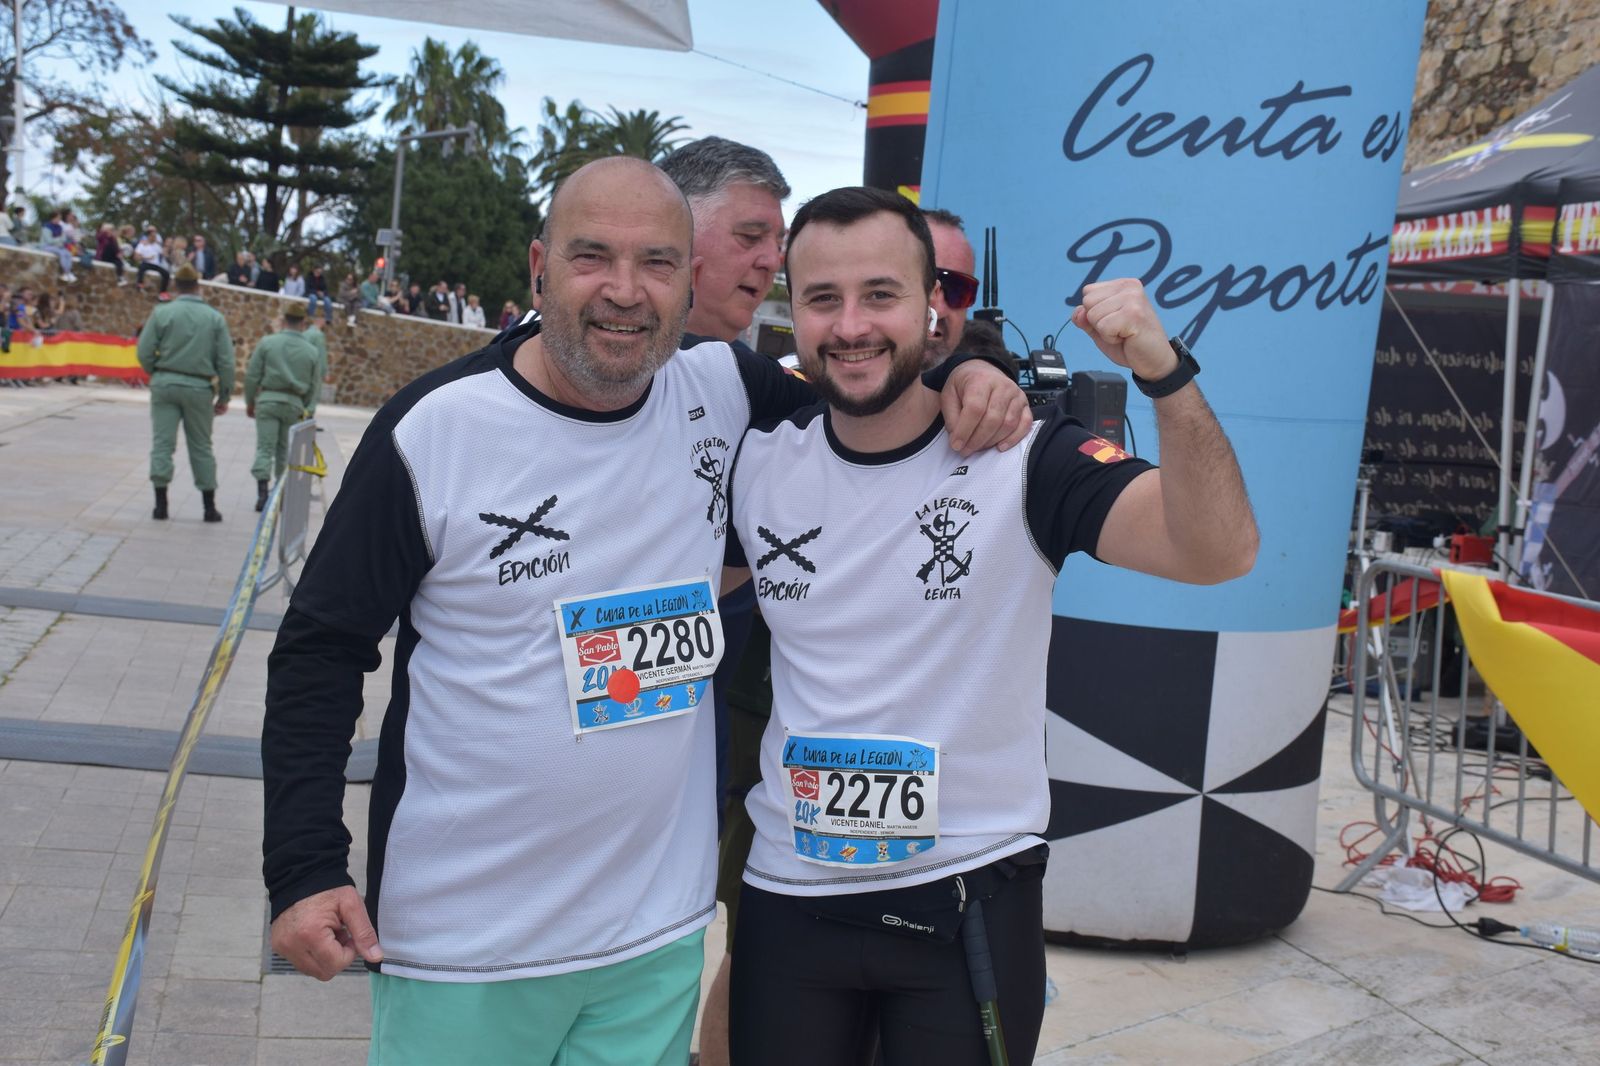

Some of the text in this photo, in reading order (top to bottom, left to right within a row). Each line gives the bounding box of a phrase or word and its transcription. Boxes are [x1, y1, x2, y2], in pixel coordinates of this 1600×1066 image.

[1062, 53, 1405, 163] Ceuta es
[1065, 217, 1390, 351] Deporte
[915, 504, 931, 520] LA
[924, 587, 961, 601] CEUTA
[578, 643, 618, 656] San Pablo
[627, 616, 715, 672] 2280
[582, 665, 627, 693] 20
[637, 669, 665, 681] VICENTE
[825, 772, 925, 821] 2276
[795, 799, 821, 825] 20K
[830, 818, 859, 828] VICENTE
[859, 820, 886, 829] DANIEL
[902, 919, 935, 934] Kalenji
